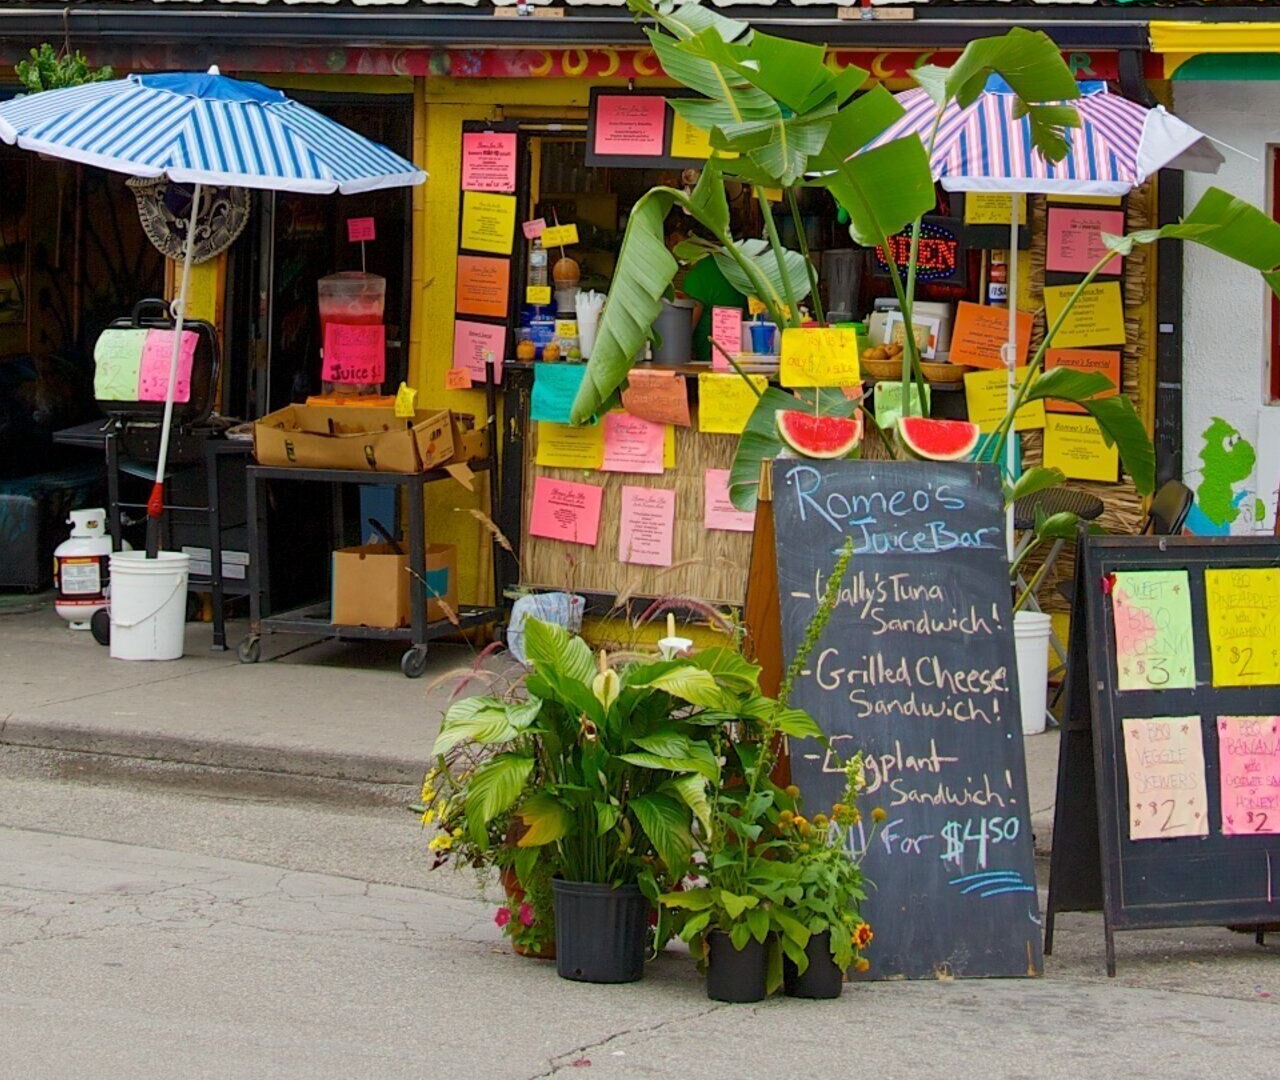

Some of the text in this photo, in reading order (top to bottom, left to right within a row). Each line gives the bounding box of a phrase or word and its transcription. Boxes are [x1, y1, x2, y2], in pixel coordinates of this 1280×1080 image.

[330, 364, 369, 381] Juice
[786, 465, 966, 532] Romeo's
[890, 572, 944, 604] Tuna
[816, 648, 912, 690] Grilled
[1136, 658, 1170, 685] $3
[1229, 646, 1263, 677] $2
[1135, 747, 1188, 765] VEGGIE
[1133, 772, 1197, 793] SKEWERS
[880, 817, 934, 854] For
